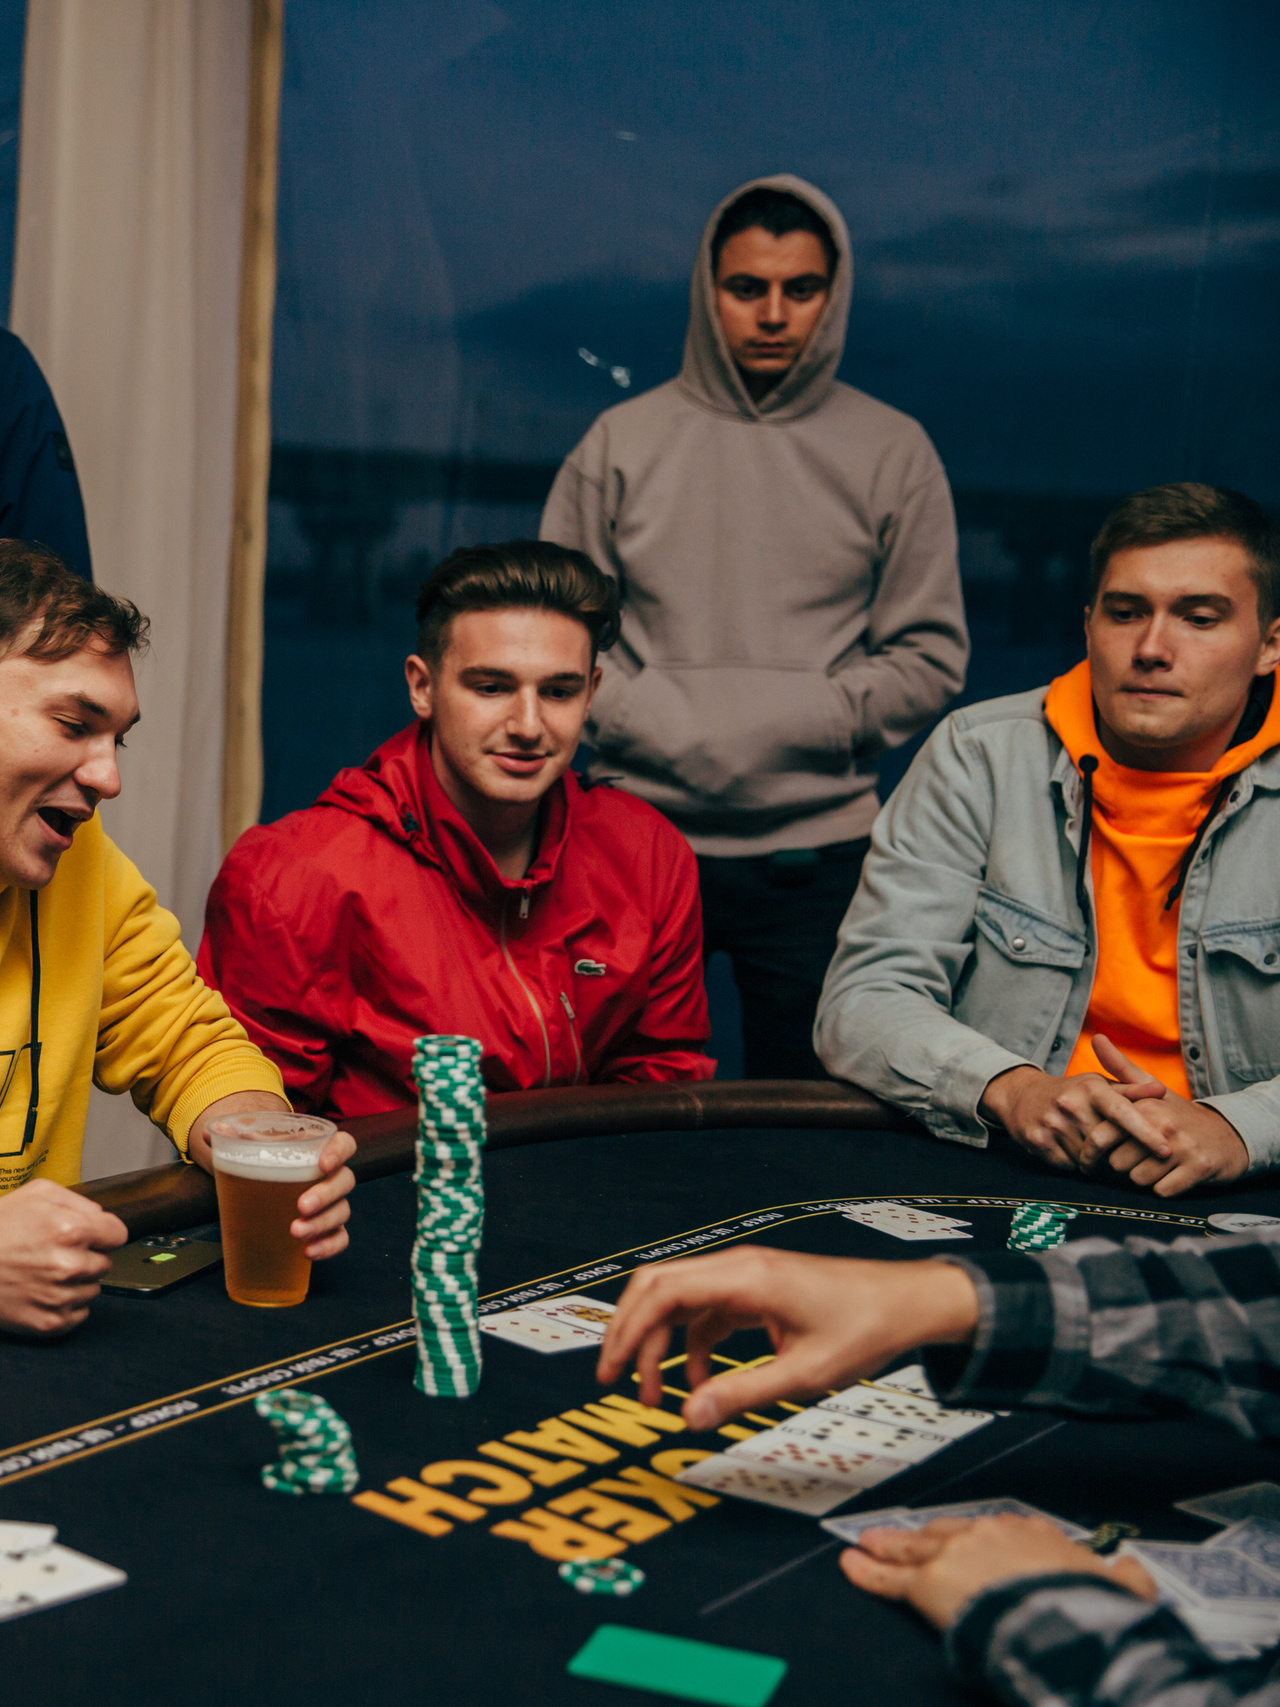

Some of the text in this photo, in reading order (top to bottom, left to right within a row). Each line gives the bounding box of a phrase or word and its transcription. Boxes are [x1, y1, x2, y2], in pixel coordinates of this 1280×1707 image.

[966, 1198, 1030, 1206] ОКЕР
[740, 1212, 784, 1227] ПОКЕР
[1179, 1217, 1204, 1225] ІЙ
[635, 1242, 687, 1259] СПОРТ!
[573, 1263, 622, 1281] ПОКЕР
[536, 1282, 565, 1292] ЦЕ
[504, 1288, 545, 1302] ТВІЙ
[477, 1299, 508, 1313] СПО
[372, 1326, 417, 1347] ОКЕР
[352, 1393, 688, 1539] MATCH
